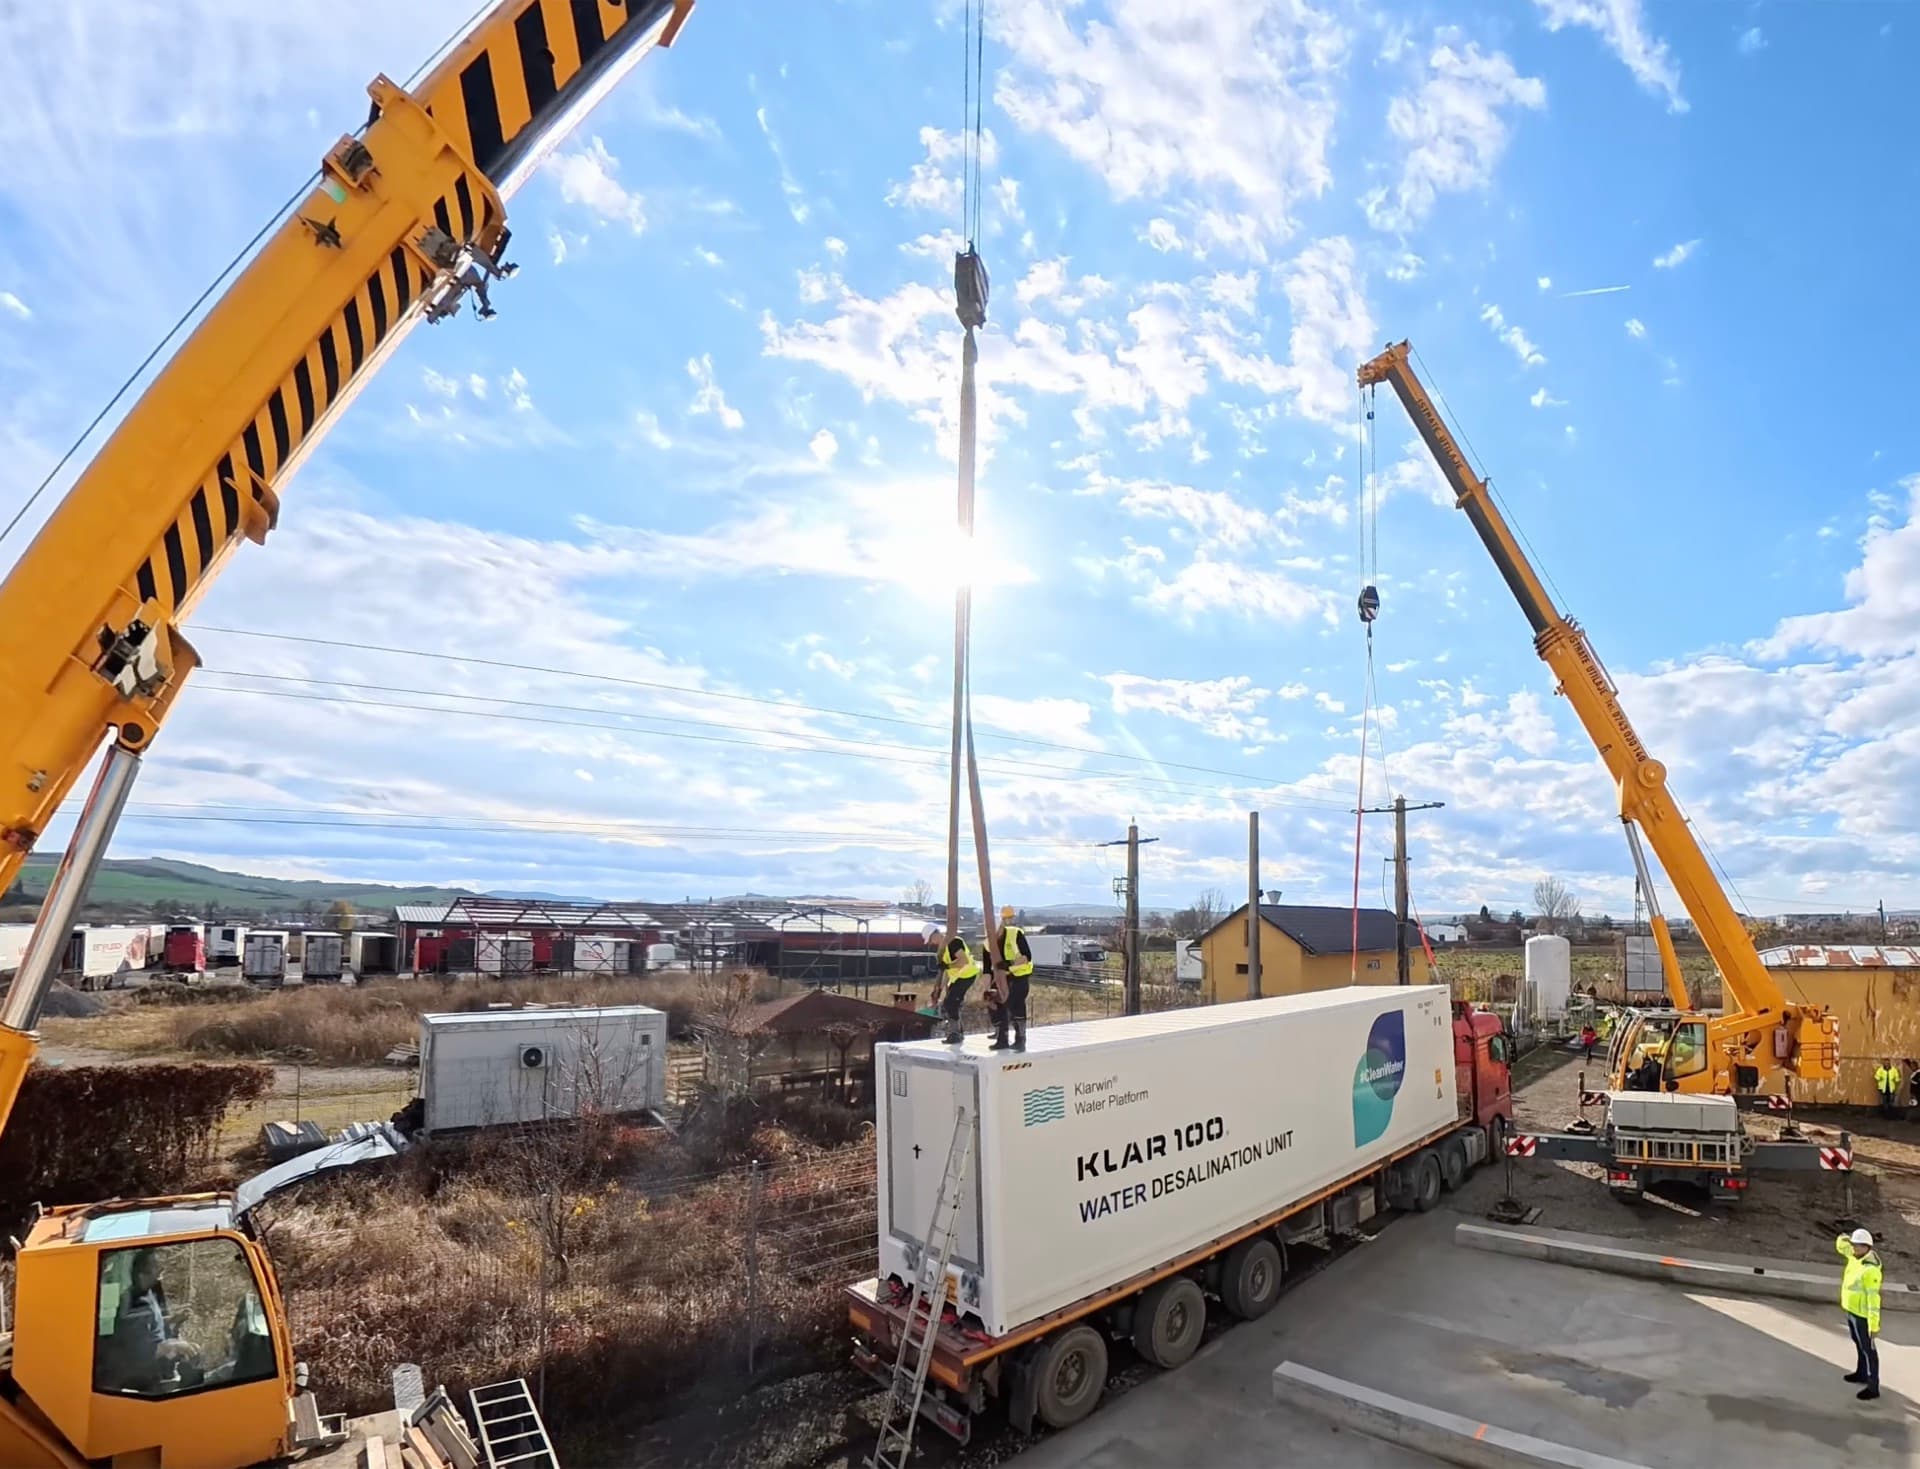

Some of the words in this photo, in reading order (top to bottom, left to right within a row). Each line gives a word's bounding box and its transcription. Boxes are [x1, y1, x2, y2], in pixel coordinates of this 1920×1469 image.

[1569, 634, 1591, 664] ISTRATE
[1586, 665, 1608, 696] UTILAJE
[1074, 1098, 1106, 1115] Water
[1108, 1089, 1149, 1108] Platform
[1360, 1060, 1404, 1083] #CleanWater
[1077, 1134, 1167, 1181] KLAR
[1174, 1116, 1224, 1152] 100
[1079, 1183, 1147, 1223] WATER
[1151, 1146, 1262, 1199] DESALINATION
[1265, 1130, 1294, 1156] UNIT
